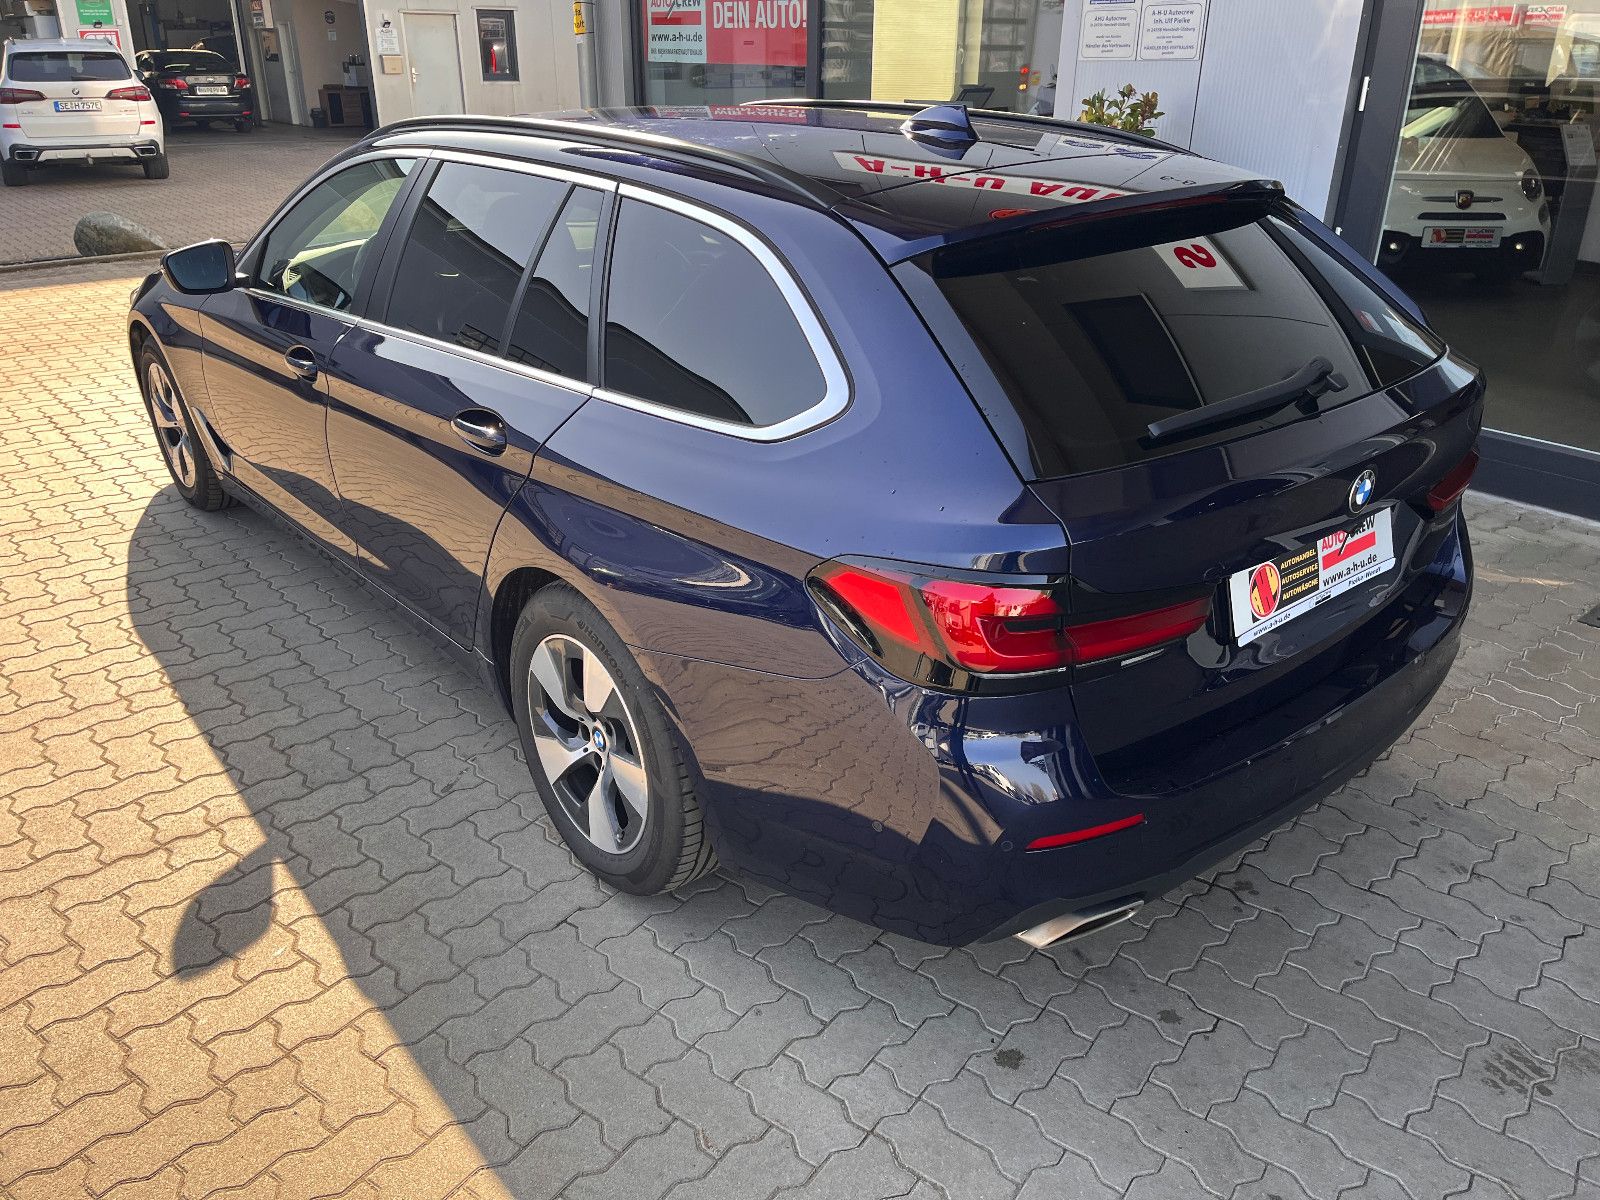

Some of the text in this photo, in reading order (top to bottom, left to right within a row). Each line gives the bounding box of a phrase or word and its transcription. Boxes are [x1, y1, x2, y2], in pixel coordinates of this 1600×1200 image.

[712, 0, 807, 28] DEIN AUTO!
[651, 32, 702, 42] www.a-h-u.de
[1322, 530, 1346, 552] AUTO
[1280, 548, 1316, 570] AUTOHANDEL
[1322, 553, 1378, 587] www.a-h-u.de
[1281, 562, 1318, 585] AUTOSERVICE
[1253, 612, 1291, 638] www.a-h-u.de
